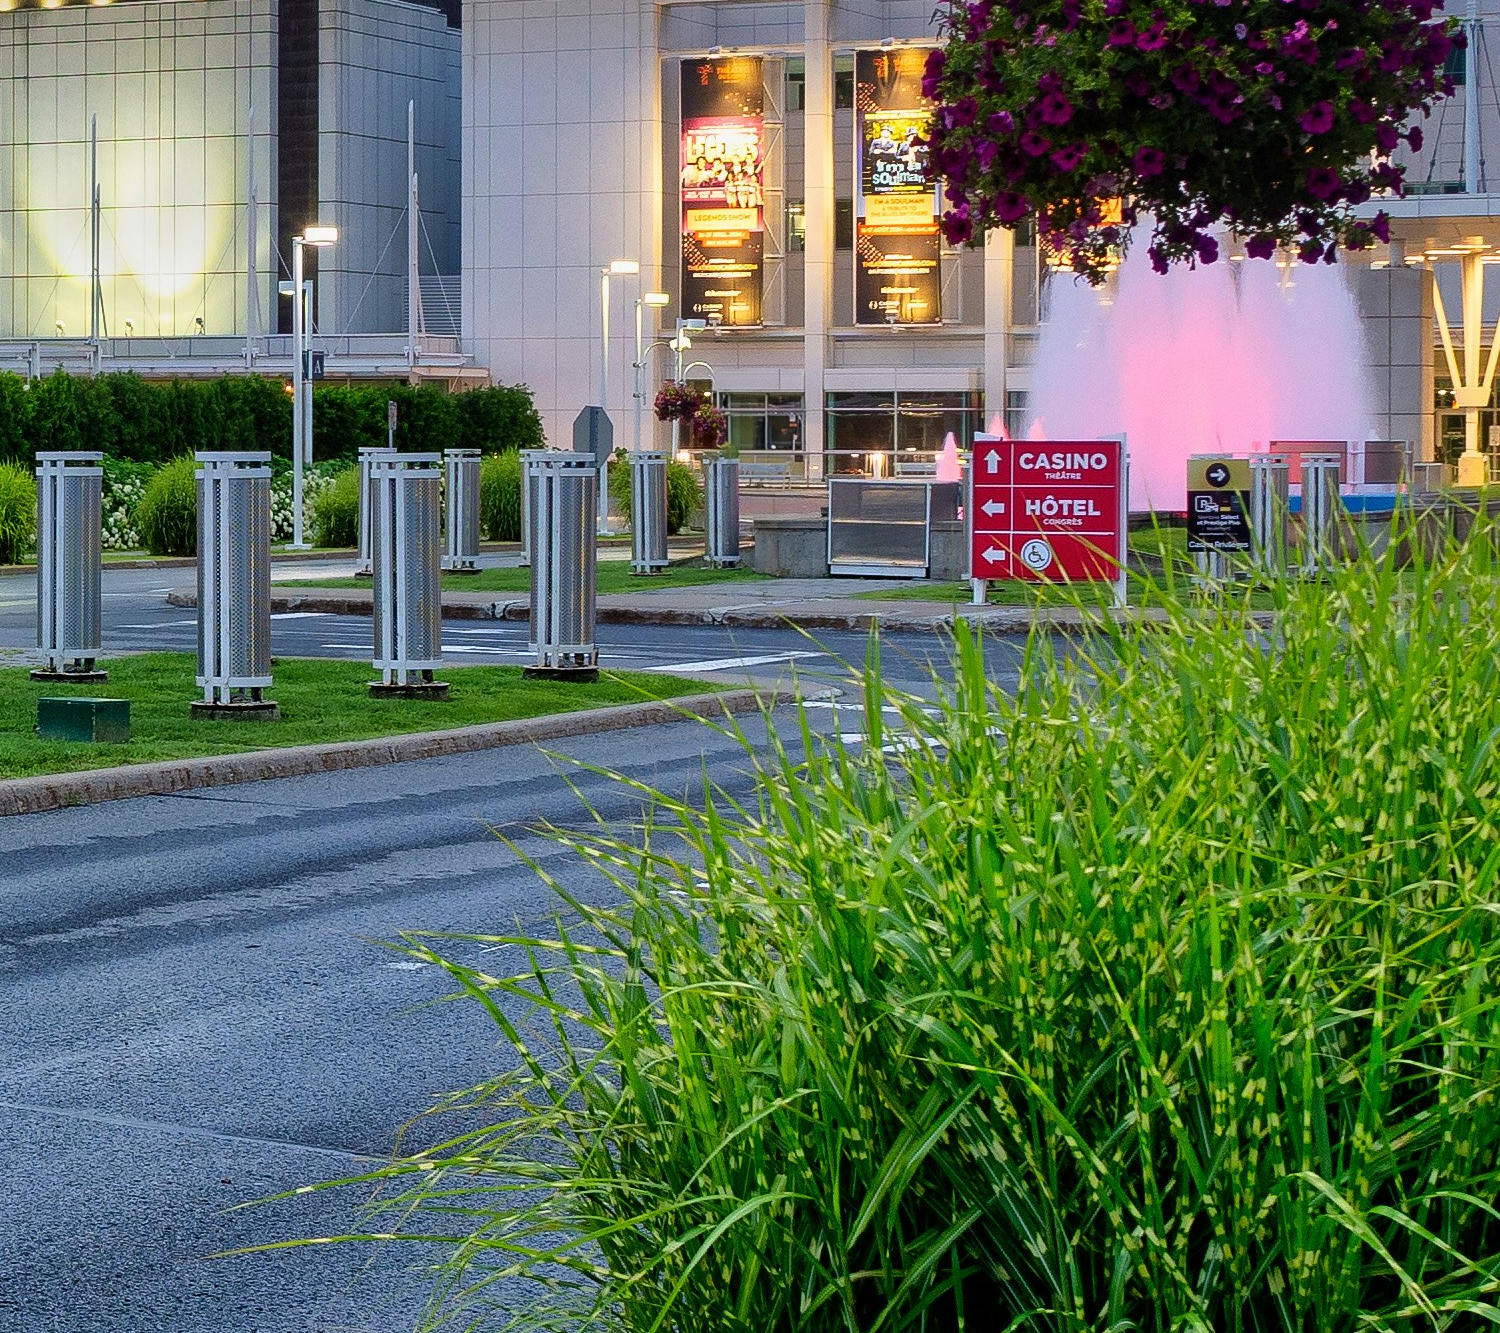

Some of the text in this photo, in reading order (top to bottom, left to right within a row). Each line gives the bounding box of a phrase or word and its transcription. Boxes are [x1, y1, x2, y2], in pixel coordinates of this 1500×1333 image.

[687, 134, 758, 163] LEGES
[728, 213, 751, 221] SHOW
[1019, 452, 1107, 470] CASINO
[1044, 471, 1082, 480] THÉÂTRE
[1025, 494, 1101, 516] HÔTEL
[1043, 517, 1083, 526] CONGRÈS
